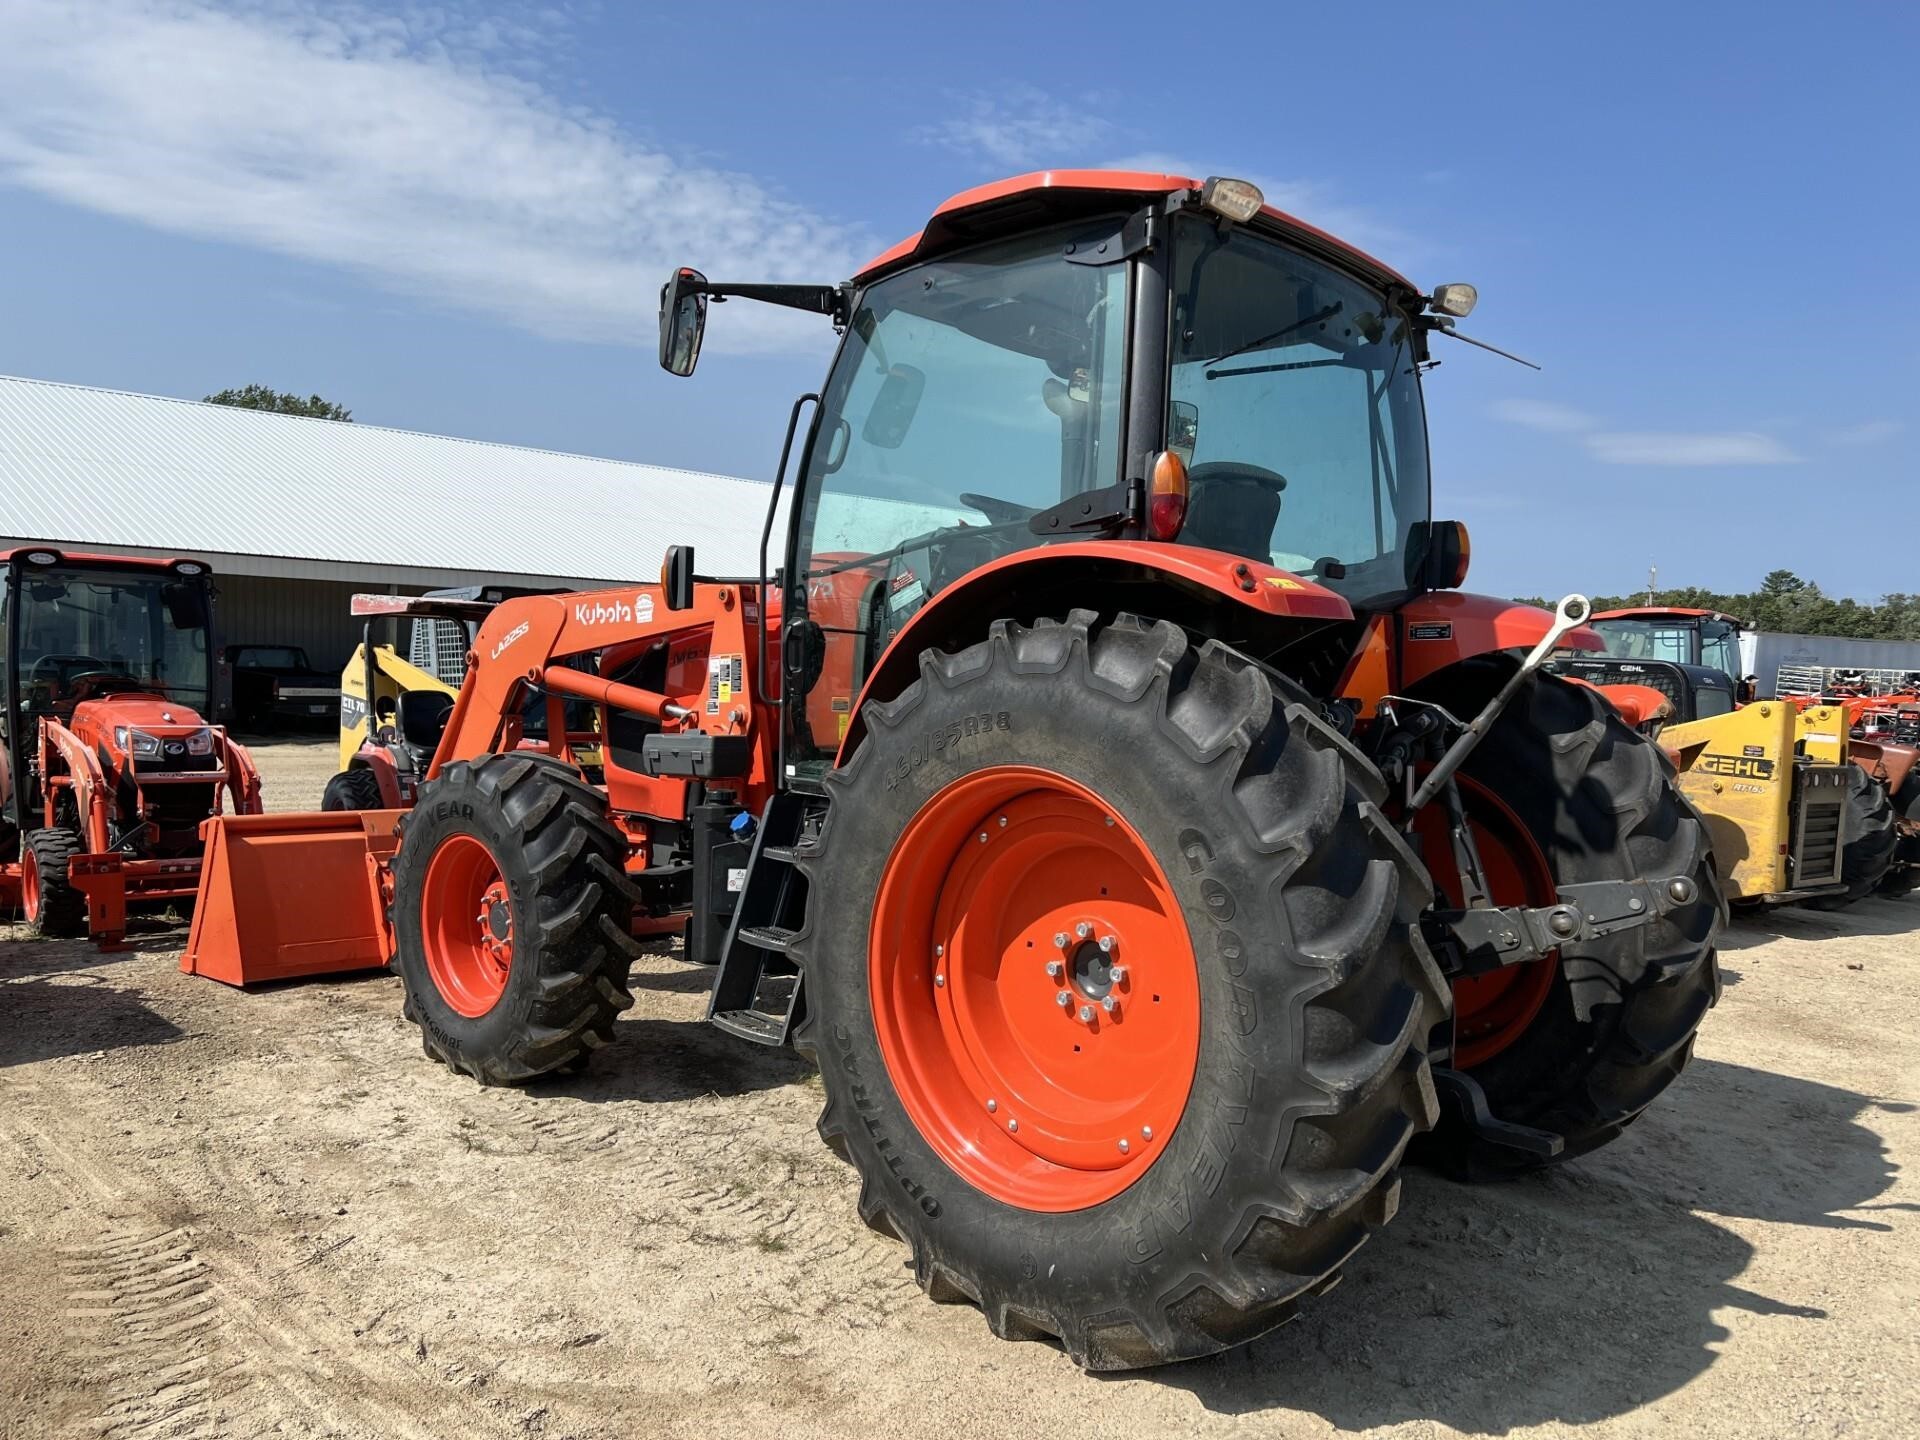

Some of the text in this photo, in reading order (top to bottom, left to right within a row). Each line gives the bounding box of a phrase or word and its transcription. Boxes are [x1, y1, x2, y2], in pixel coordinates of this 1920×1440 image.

[575, 599, 632, 626] Kubota
[491, 620, 529, 660] LA2255
[1619, 664, 1646, 673] GEHL
[355, 700, 365, 713] 70
[886, 711, 1011, 793] 460/85R38
[1702, 756, 1769, 778] GEHL
[1122, 827, 1258, 1265] GOODYEAR
[833, 1023, 944, 1220] OPTITRAC
